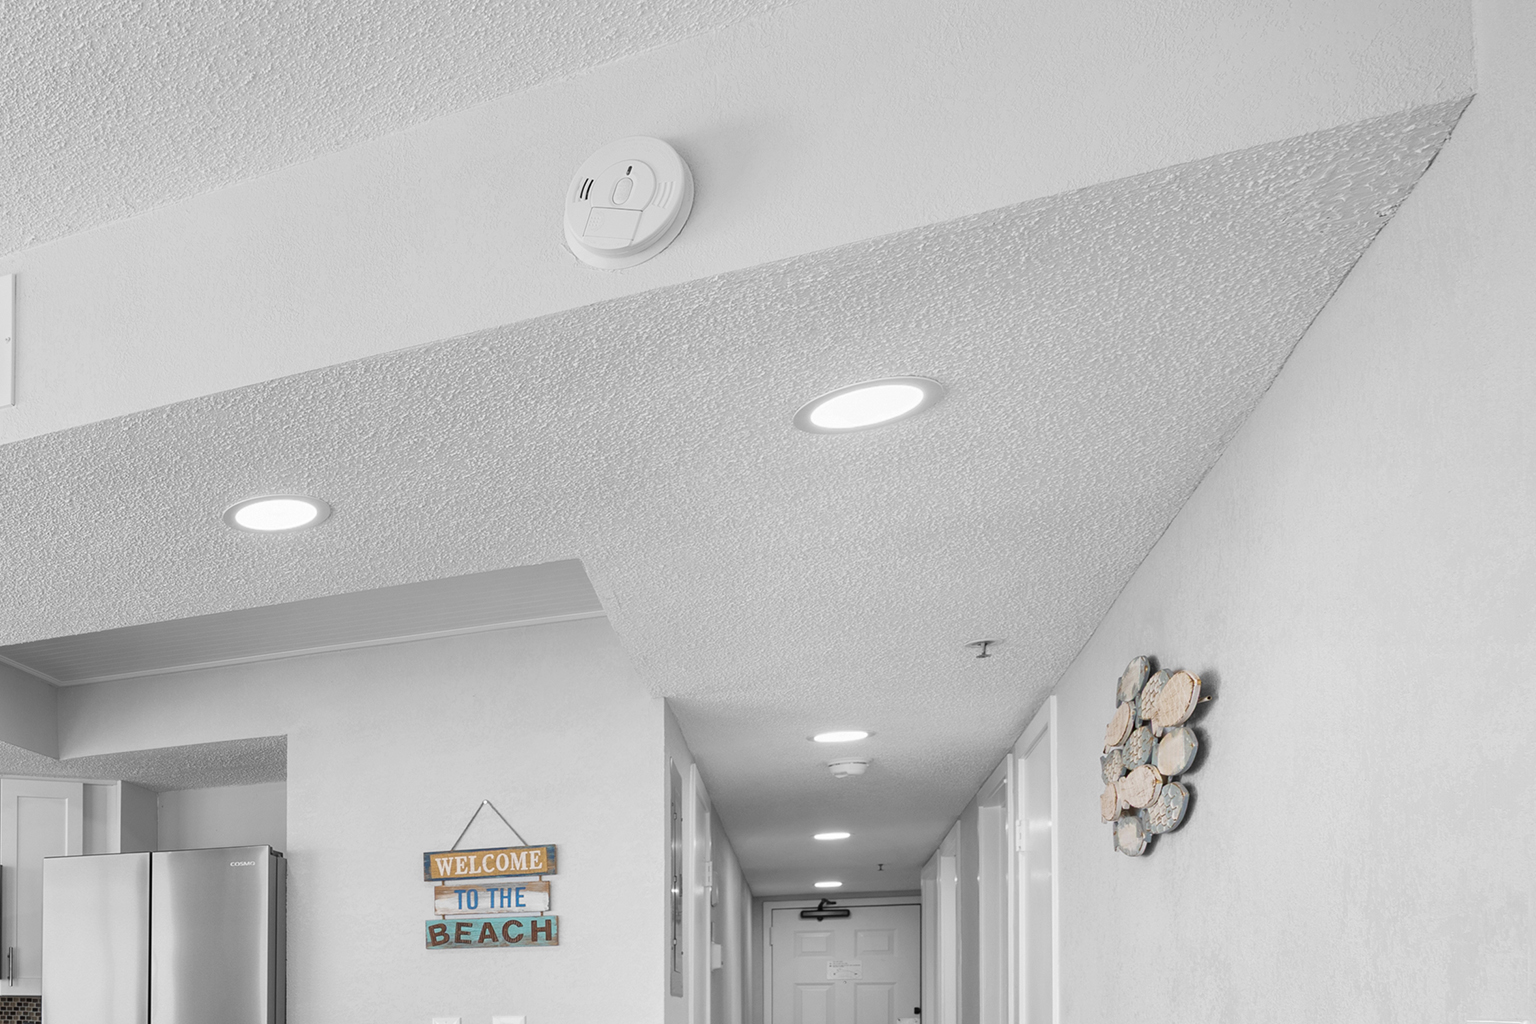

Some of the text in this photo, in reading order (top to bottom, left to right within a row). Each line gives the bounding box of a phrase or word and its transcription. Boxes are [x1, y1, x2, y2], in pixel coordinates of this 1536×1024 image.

[434, 850, 543, 877] WELCOME
[454, 887, 527, 910] TO THE
[428, 919, 553, 947] BEACH
